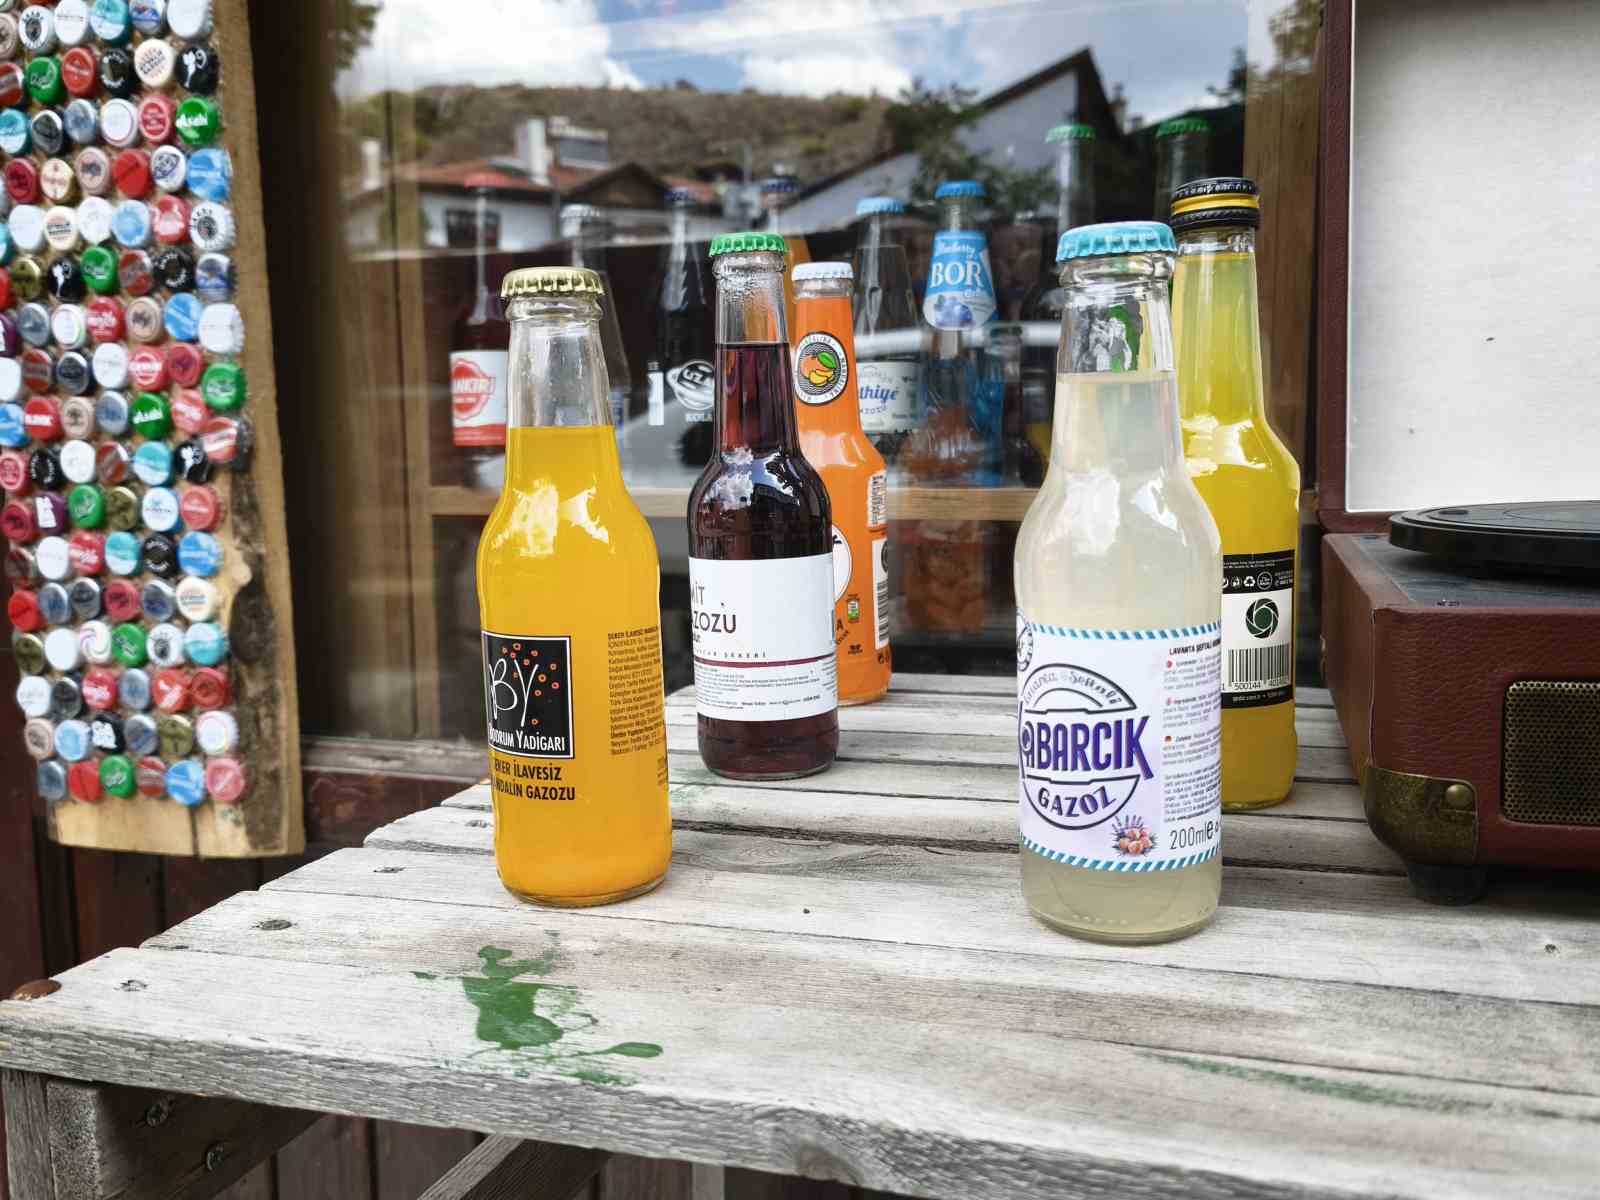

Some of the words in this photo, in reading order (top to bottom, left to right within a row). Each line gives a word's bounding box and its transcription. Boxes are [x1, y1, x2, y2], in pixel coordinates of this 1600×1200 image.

[930, 261, 984, 288] BOR
[526, 786, 575, 801] GAZOZU
[1038, 785, 1117, 818] GAZOZ
